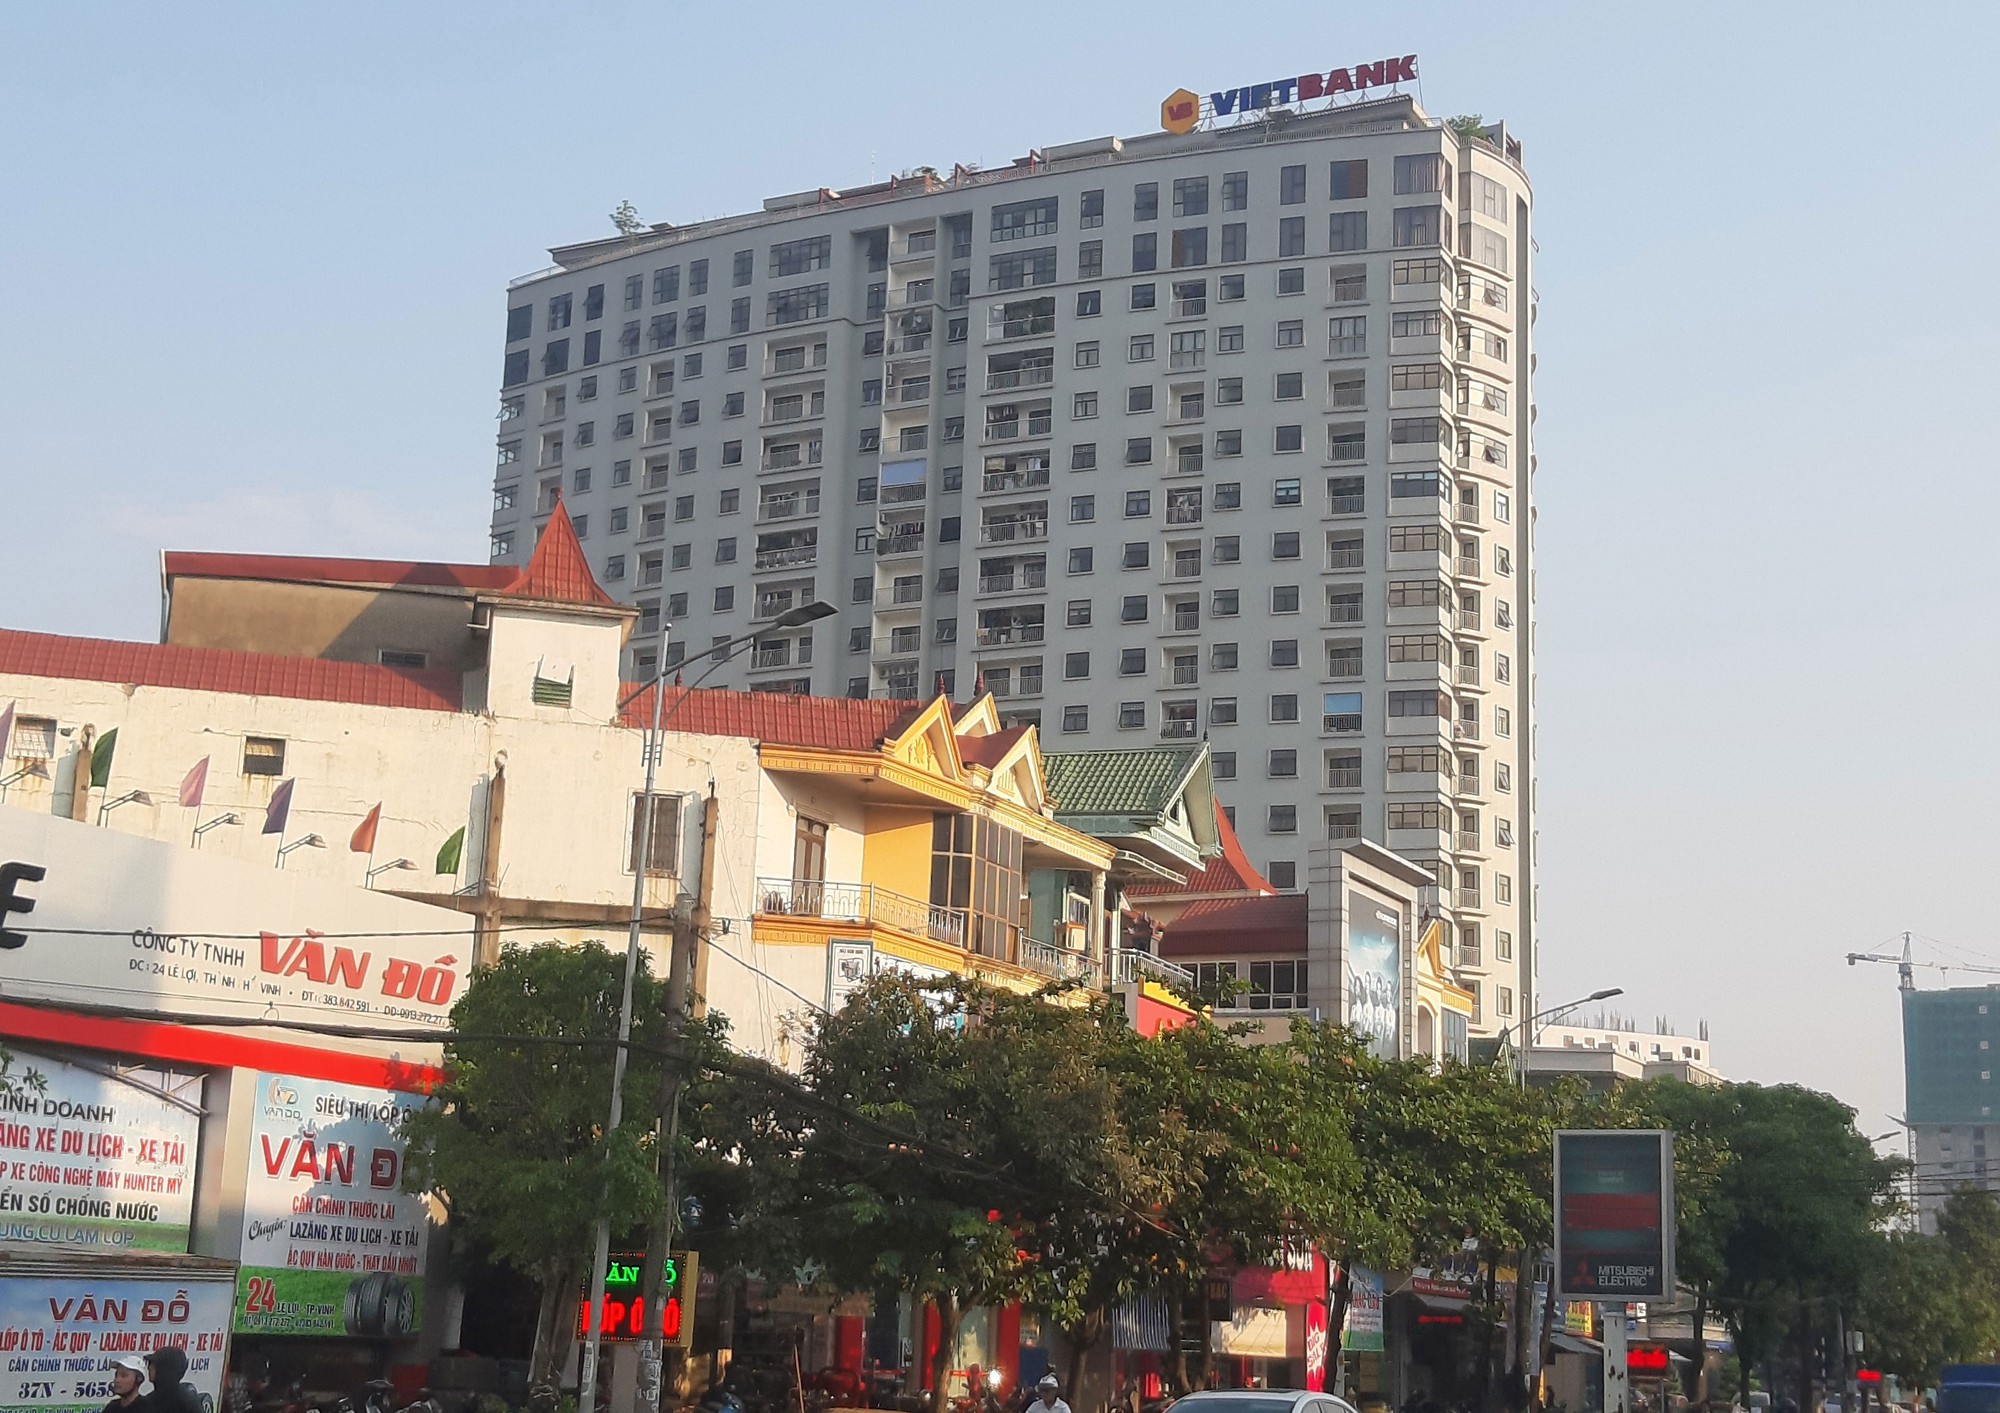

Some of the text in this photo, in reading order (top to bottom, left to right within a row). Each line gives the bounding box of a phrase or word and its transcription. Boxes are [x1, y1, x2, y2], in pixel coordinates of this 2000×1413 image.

[1210, 54, 1418, 116] VIETBANK
[132, 926, 245, 967] CÔNG TY TNHH
[152, 963, 165, 975] 24
[260, 982, 281, 995] VINH
[43, 1098, 114, 1123] DOANH
[316, 1094, 345, 1115] SIÊU
[35, 1127, 56, 1151] XE
[87, 1132, 123, 1162] LỊCH
[138, 1138, 157, 1163] XE
[162, 1135, 185, 1165] TẢI
[260, 1130, 405, 1189] VĂN Đ
[11, 1162, 26, 1181] XE
[29, 1161, 61, 1184] CÔNG
[96, 1169, 121, 1189] MÁY
[123, 1173, 164, 1194] HUNTER
[29, 1190, 51, 1213] SỐ
[55, 1193, 111, 1218] CHỐNG
[116, 1200, 158, 1222] NƯỚC
[289, 1220, 328, 1241] LAZĂNG
[330, 1225, 342, 1242] XE
[345, 1226, 358, 1243] DU
[360, 1227, 382, 1248] LỊCH
[390, 1229, 401, 1245] XE
[606, 1261, 640, 1283] ĂN
[1598, 1265, 1654, 1276] MITSUBISHI
[1598, 1275, 1647, 1286] ELECTRIC
[49, 1289, 190, 1323] VĂN ĐỖ
[246, 1276, 276, 1313] 24
[21, 1328, 29, 1352] Ô
[31, 1328, 44, 1352] TÔ
[52, 1325, 68, 1352] ẮC
[70, 1331, 91, 1353] QUY
[99, 1329, 137, 1352] LAZĂNG
[138, 1332, 151, 1352] XE
[196, 1332, 209, 1352] XE
[210, 1327, 224, 1352] TẢI
[8, 1356, 29, 1372] CÂN
[190, 1357, 210, 1374] LỊCH
[19, 1382, 55, 1399] 37N
